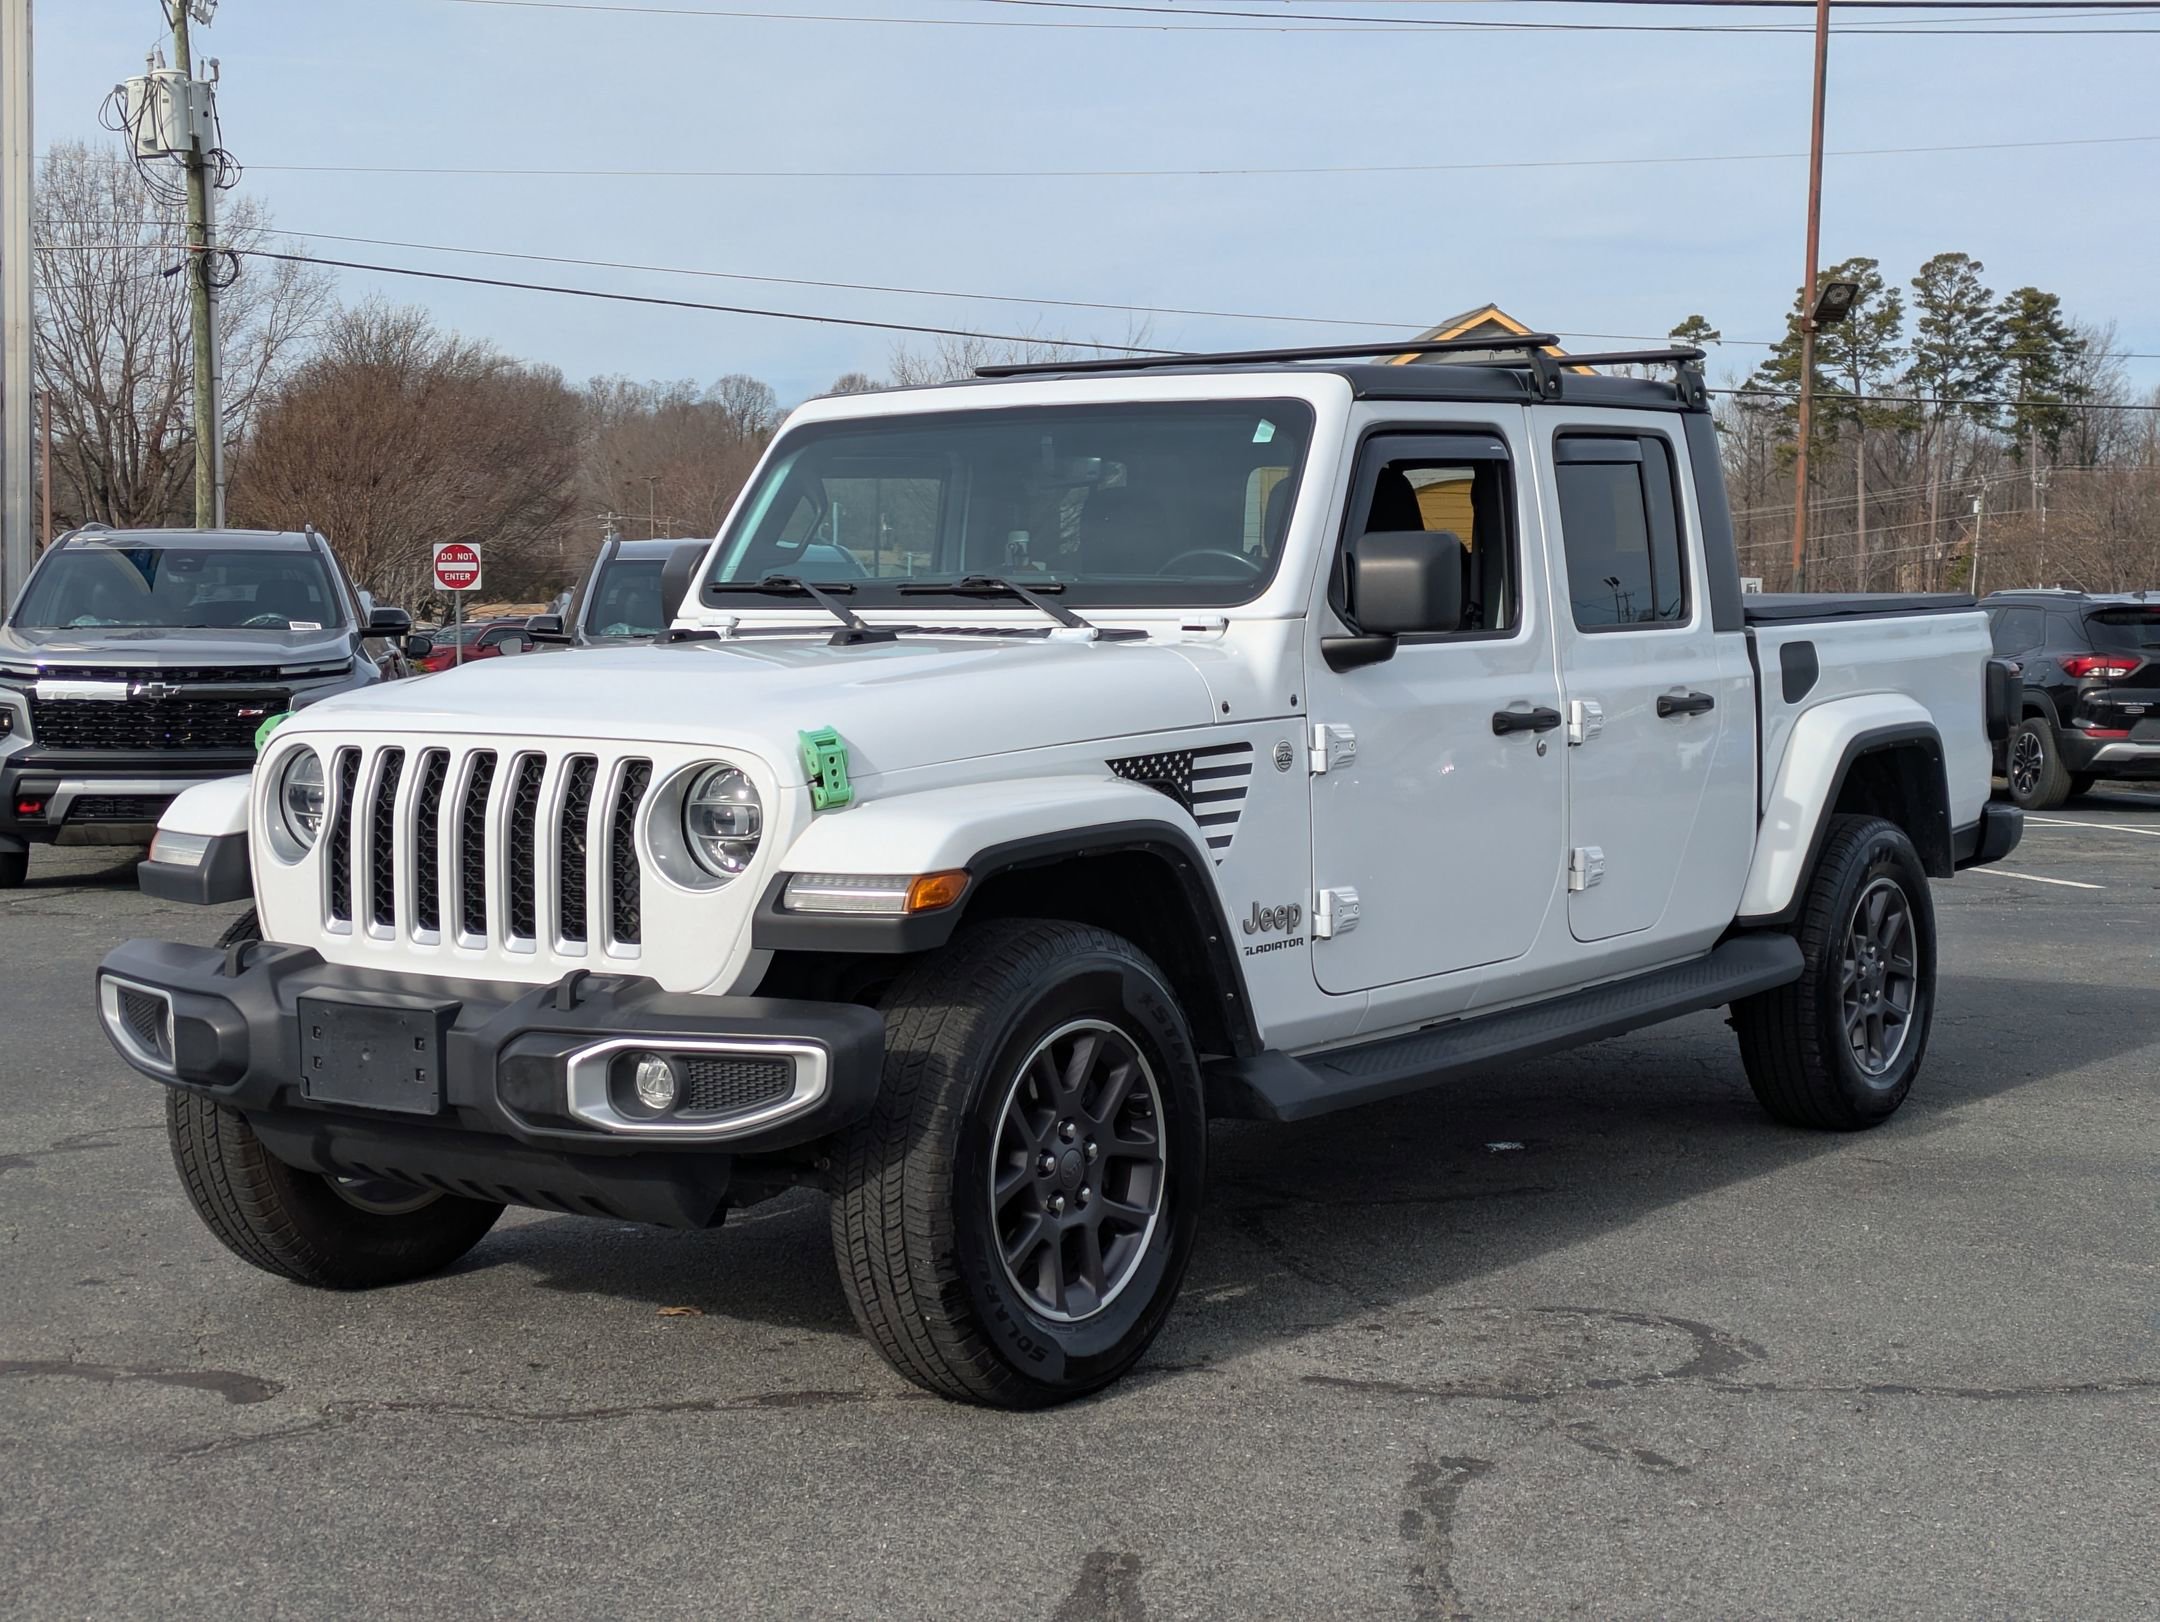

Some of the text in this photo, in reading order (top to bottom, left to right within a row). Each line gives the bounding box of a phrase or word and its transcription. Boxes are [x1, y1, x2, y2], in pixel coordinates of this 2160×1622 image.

[441, 552, 474, 561] DO NOT
[444, 572, 471, 581] ENTER
[1242, 901, 1302, 935] Jeep
